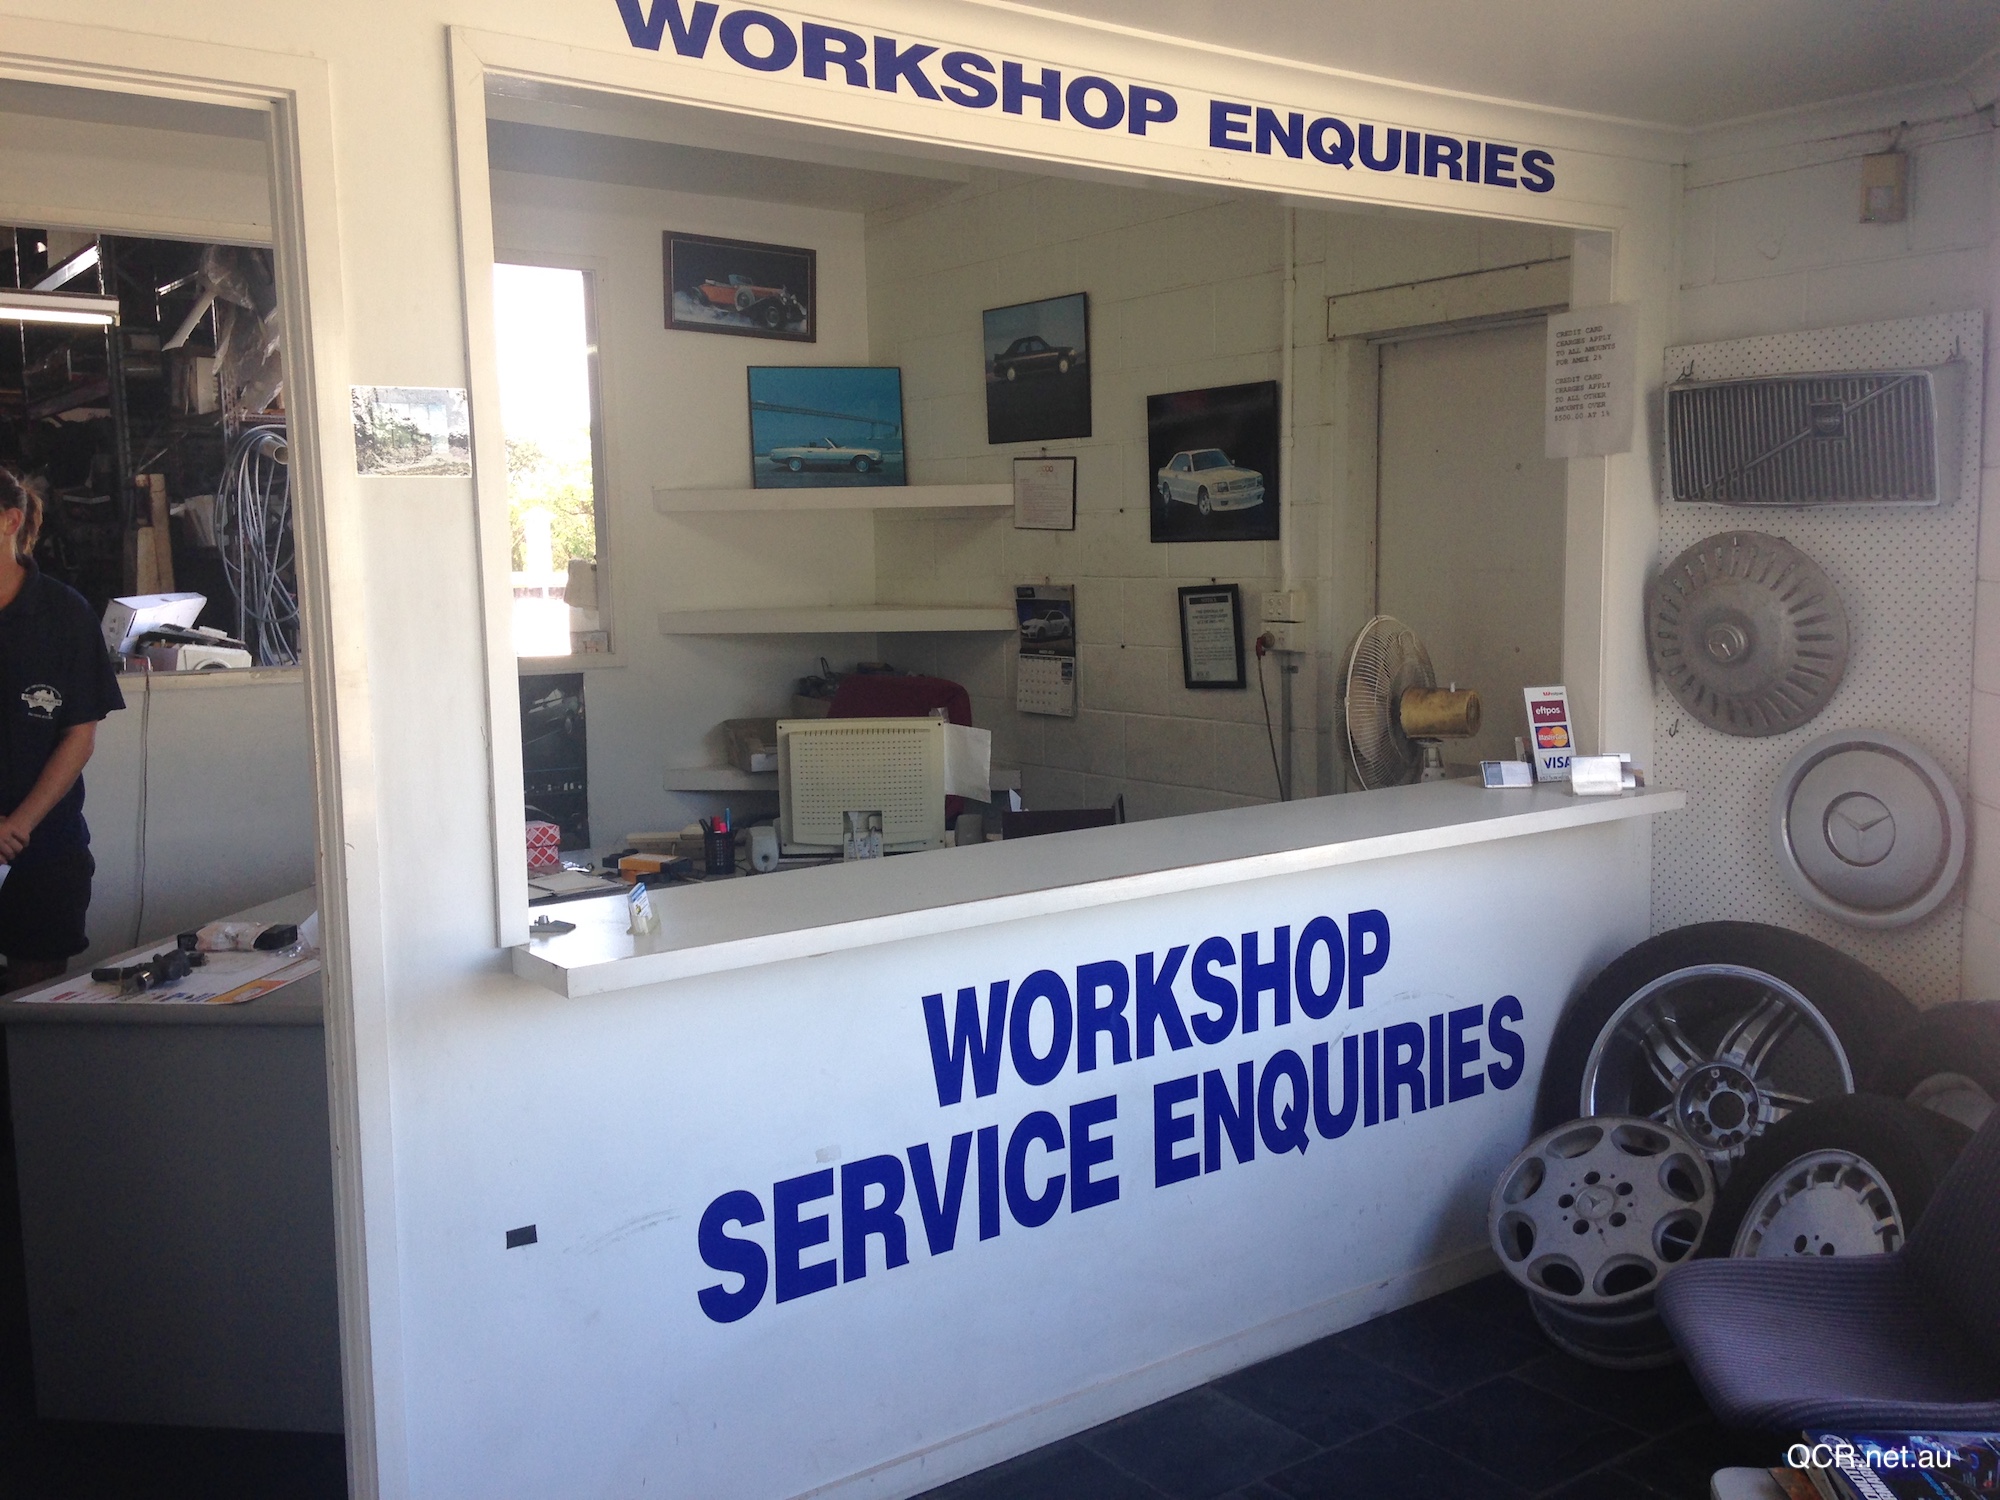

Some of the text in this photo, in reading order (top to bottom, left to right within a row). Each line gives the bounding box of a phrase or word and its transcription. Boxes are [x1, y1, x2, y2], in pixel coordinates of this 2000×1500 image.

[615, 0, 1555, 193] WORKSHOP ENQUIRIES
[1556, 326, 1603, 338] CREDIT CARD
[1556, 334, 1611, 347] CHARGES APPLY
[1585, 343, 1616, 352] AMOUNTS
[1555, 376, 1580, 385] CREDIT
[1555, 382, 1611, 394] CHARGES APPLY
[1583, 392, 1606, 400] OTHER
[1554, 401, 1606, 412] AMOUNTS OVER
[1536, 705, 1561, 716] eftpos
[1538, 733, 1567, 741] MasterCard
[1543, 756, 1570, 769] VISA
[922, 908, 1391, 1107] WORKSHOP
[697, 994, 1526, 1324] SERVICE ENQUIRIES
